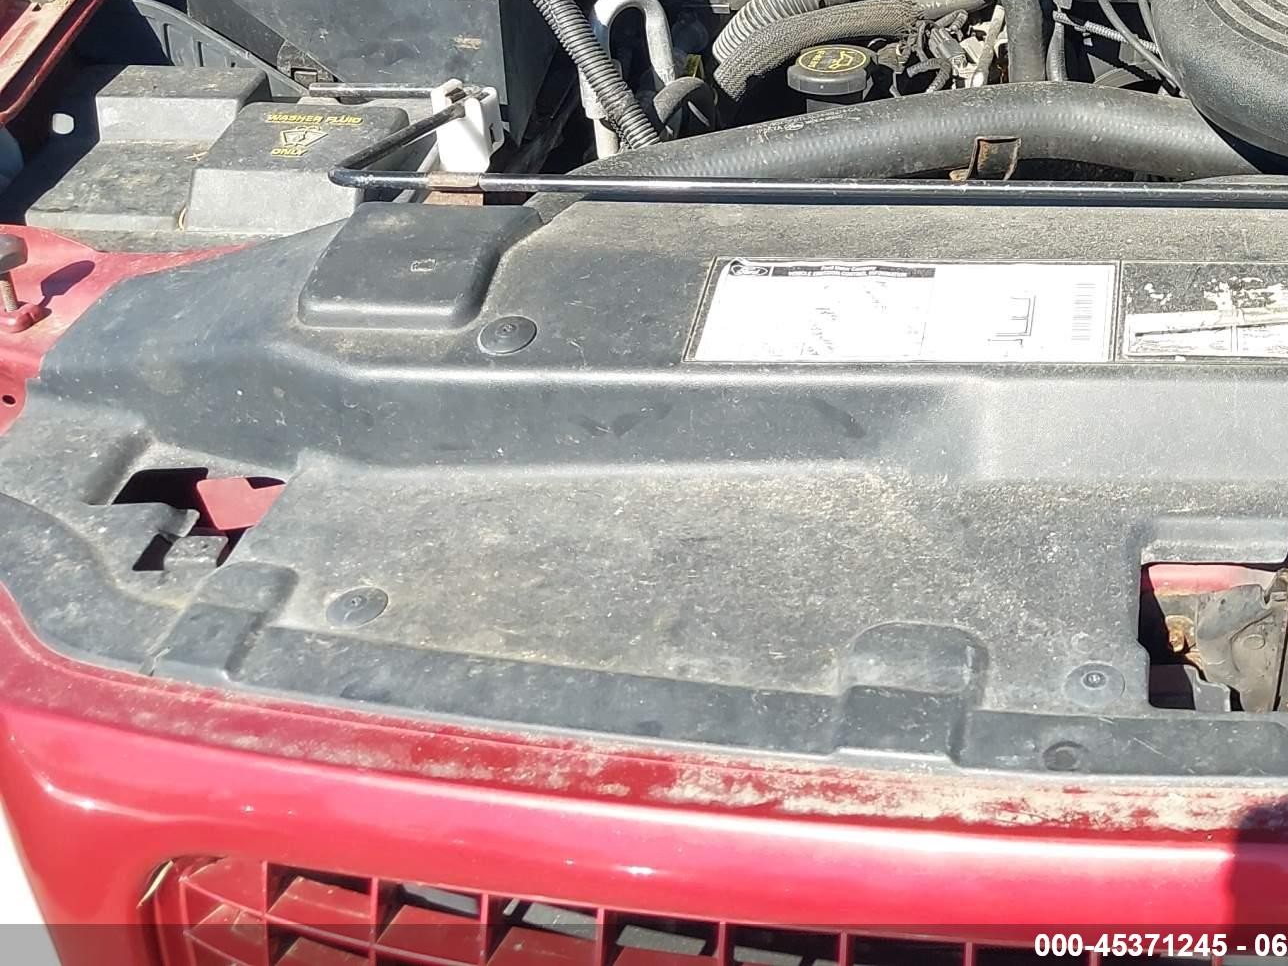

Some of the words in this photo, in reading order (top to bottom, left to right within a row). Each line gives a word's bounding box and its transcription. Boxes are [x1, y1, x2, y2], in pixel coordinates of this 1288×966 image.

[265, 114, 323, 123] WASHER
[325, 115, 363, 124] FLUID
[271, 148, 307, 156] ONLY
